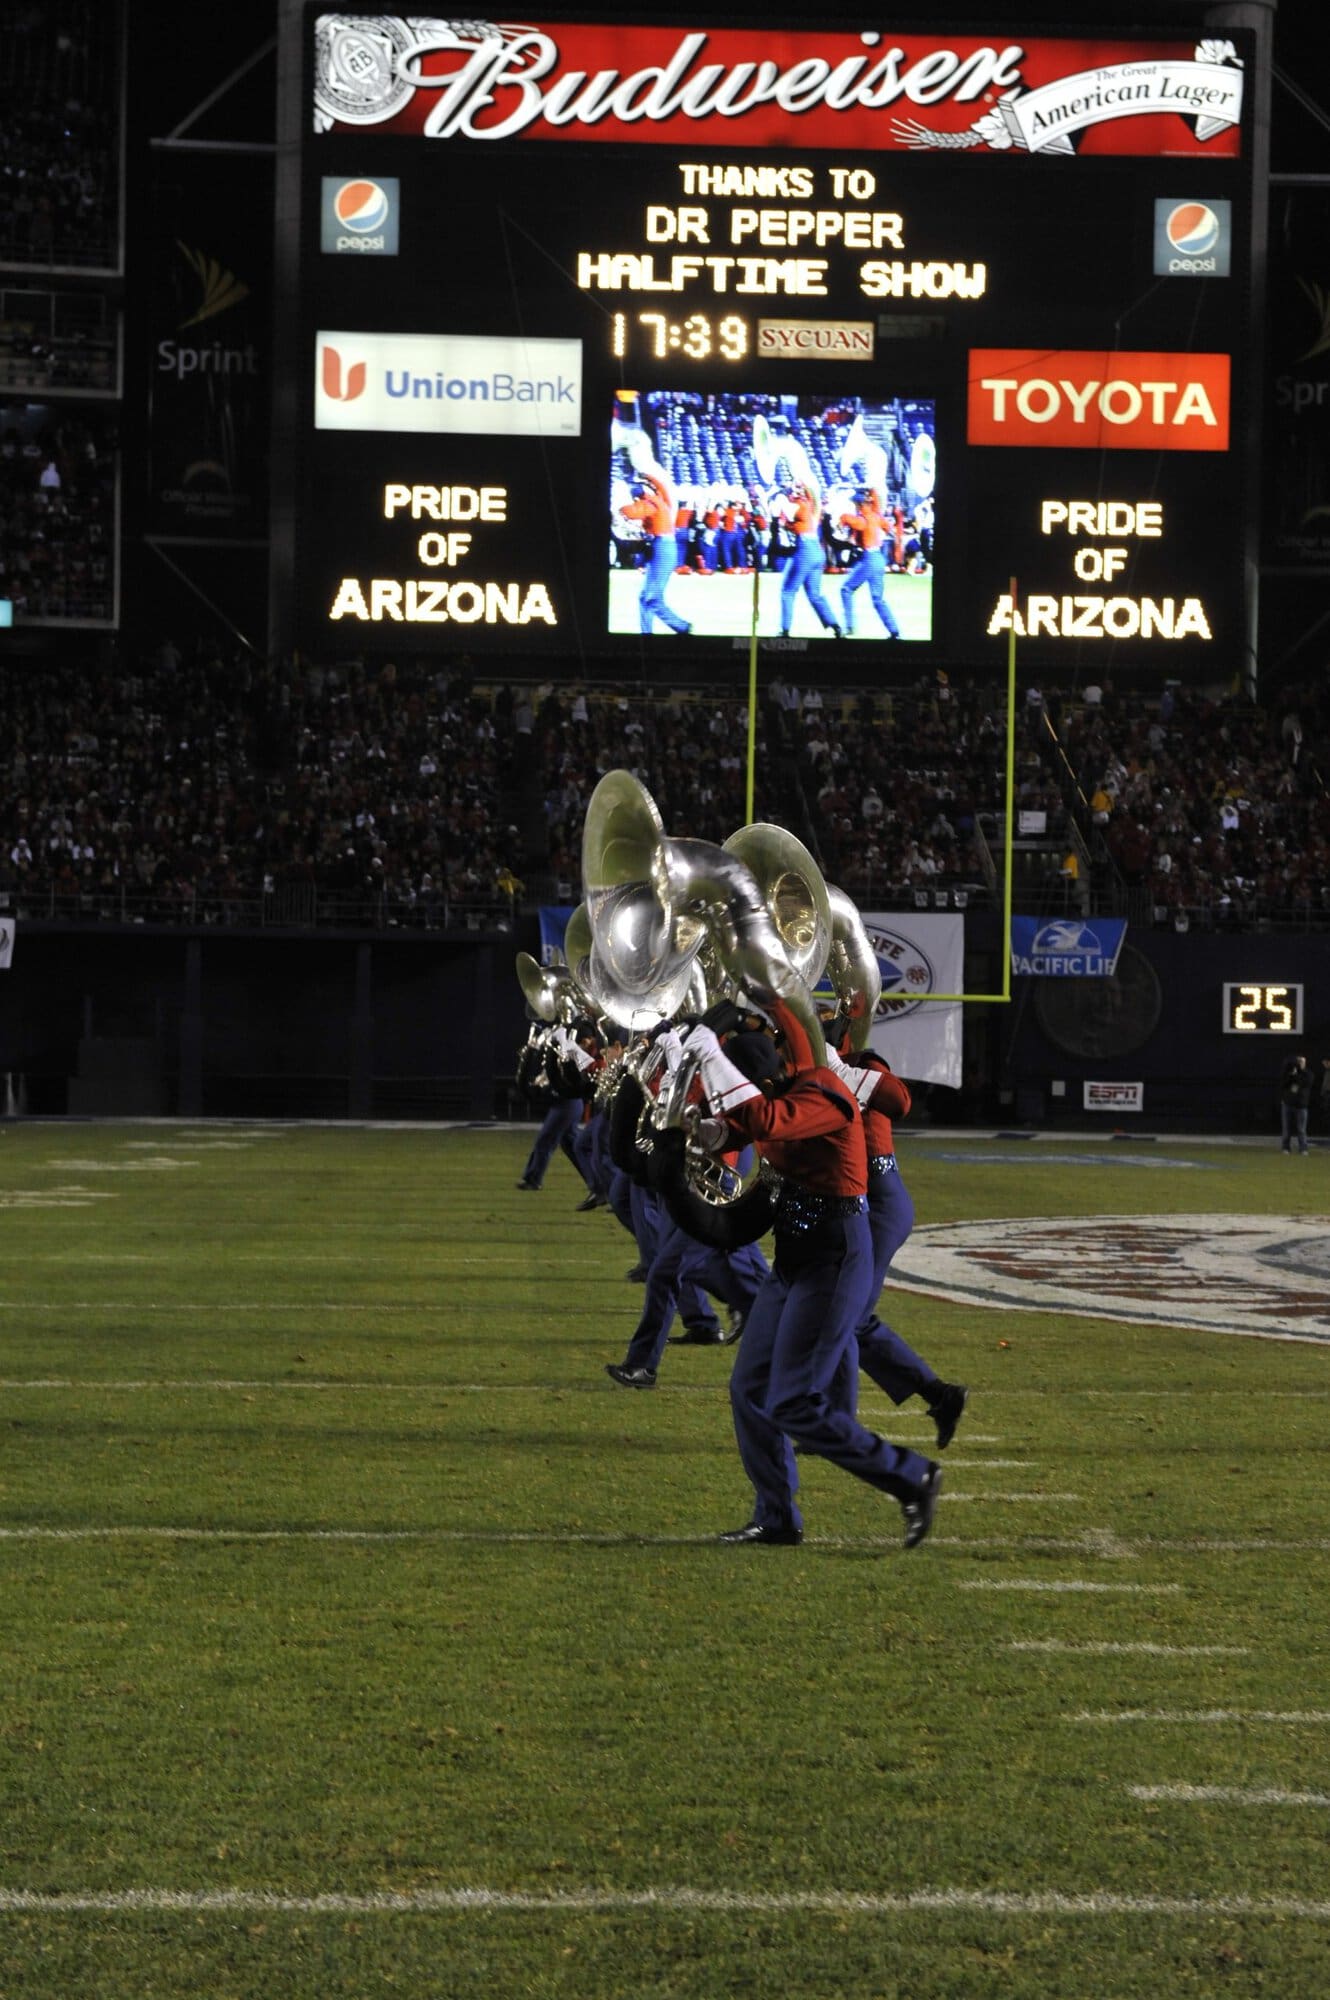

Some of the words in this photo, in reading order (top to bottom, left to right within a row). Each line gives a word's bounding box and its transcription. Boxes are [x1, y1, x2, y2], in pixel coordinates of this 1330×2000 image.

[397, 31, 1022, 139] Budweiser
[1096, 71, 1118, 81] The
[1122, 65, 1158, 77] Great
[1031, 83, 1150, 135] American
[1160, 77, 1235, 108] Lager
[679, 163, 813, 202] THANKS
[829, 168, 876, 200] TO
[336, 234, 385, 252] pepsi
[646, 206, 711, 244] DR
[731, 209, 905, 249] PEPPER
[577, 252, 829, 295] HALFTIME
[860, 260, 987, 300] SHOW
[1169, 256, 1216, 273] pepsi
[612, 311, 749, 362] 17:39
[762, 328, 871, 349] SYCUAN
[158, 340, 259, 380] Sprint
[386, 371, 576, 403] UnionBank
[981, 379, 1218, 426] TOYOTA
[384, 484, 507, 522] PRIDE
[1041, 500, 1163, 538] PRIDE
[418, 532, 472, 567] OF
[1074, 547, 1129, 582] OF
[329, 578, 558, 625] ARIZONA
[987, 594, 1213, 640] ARIZONA
[1012, 955, 1082, 976] PACIFIC
[1235, 986, 1292, 1030] 25
[1089, 1085, 1137, 1099] ESPN
